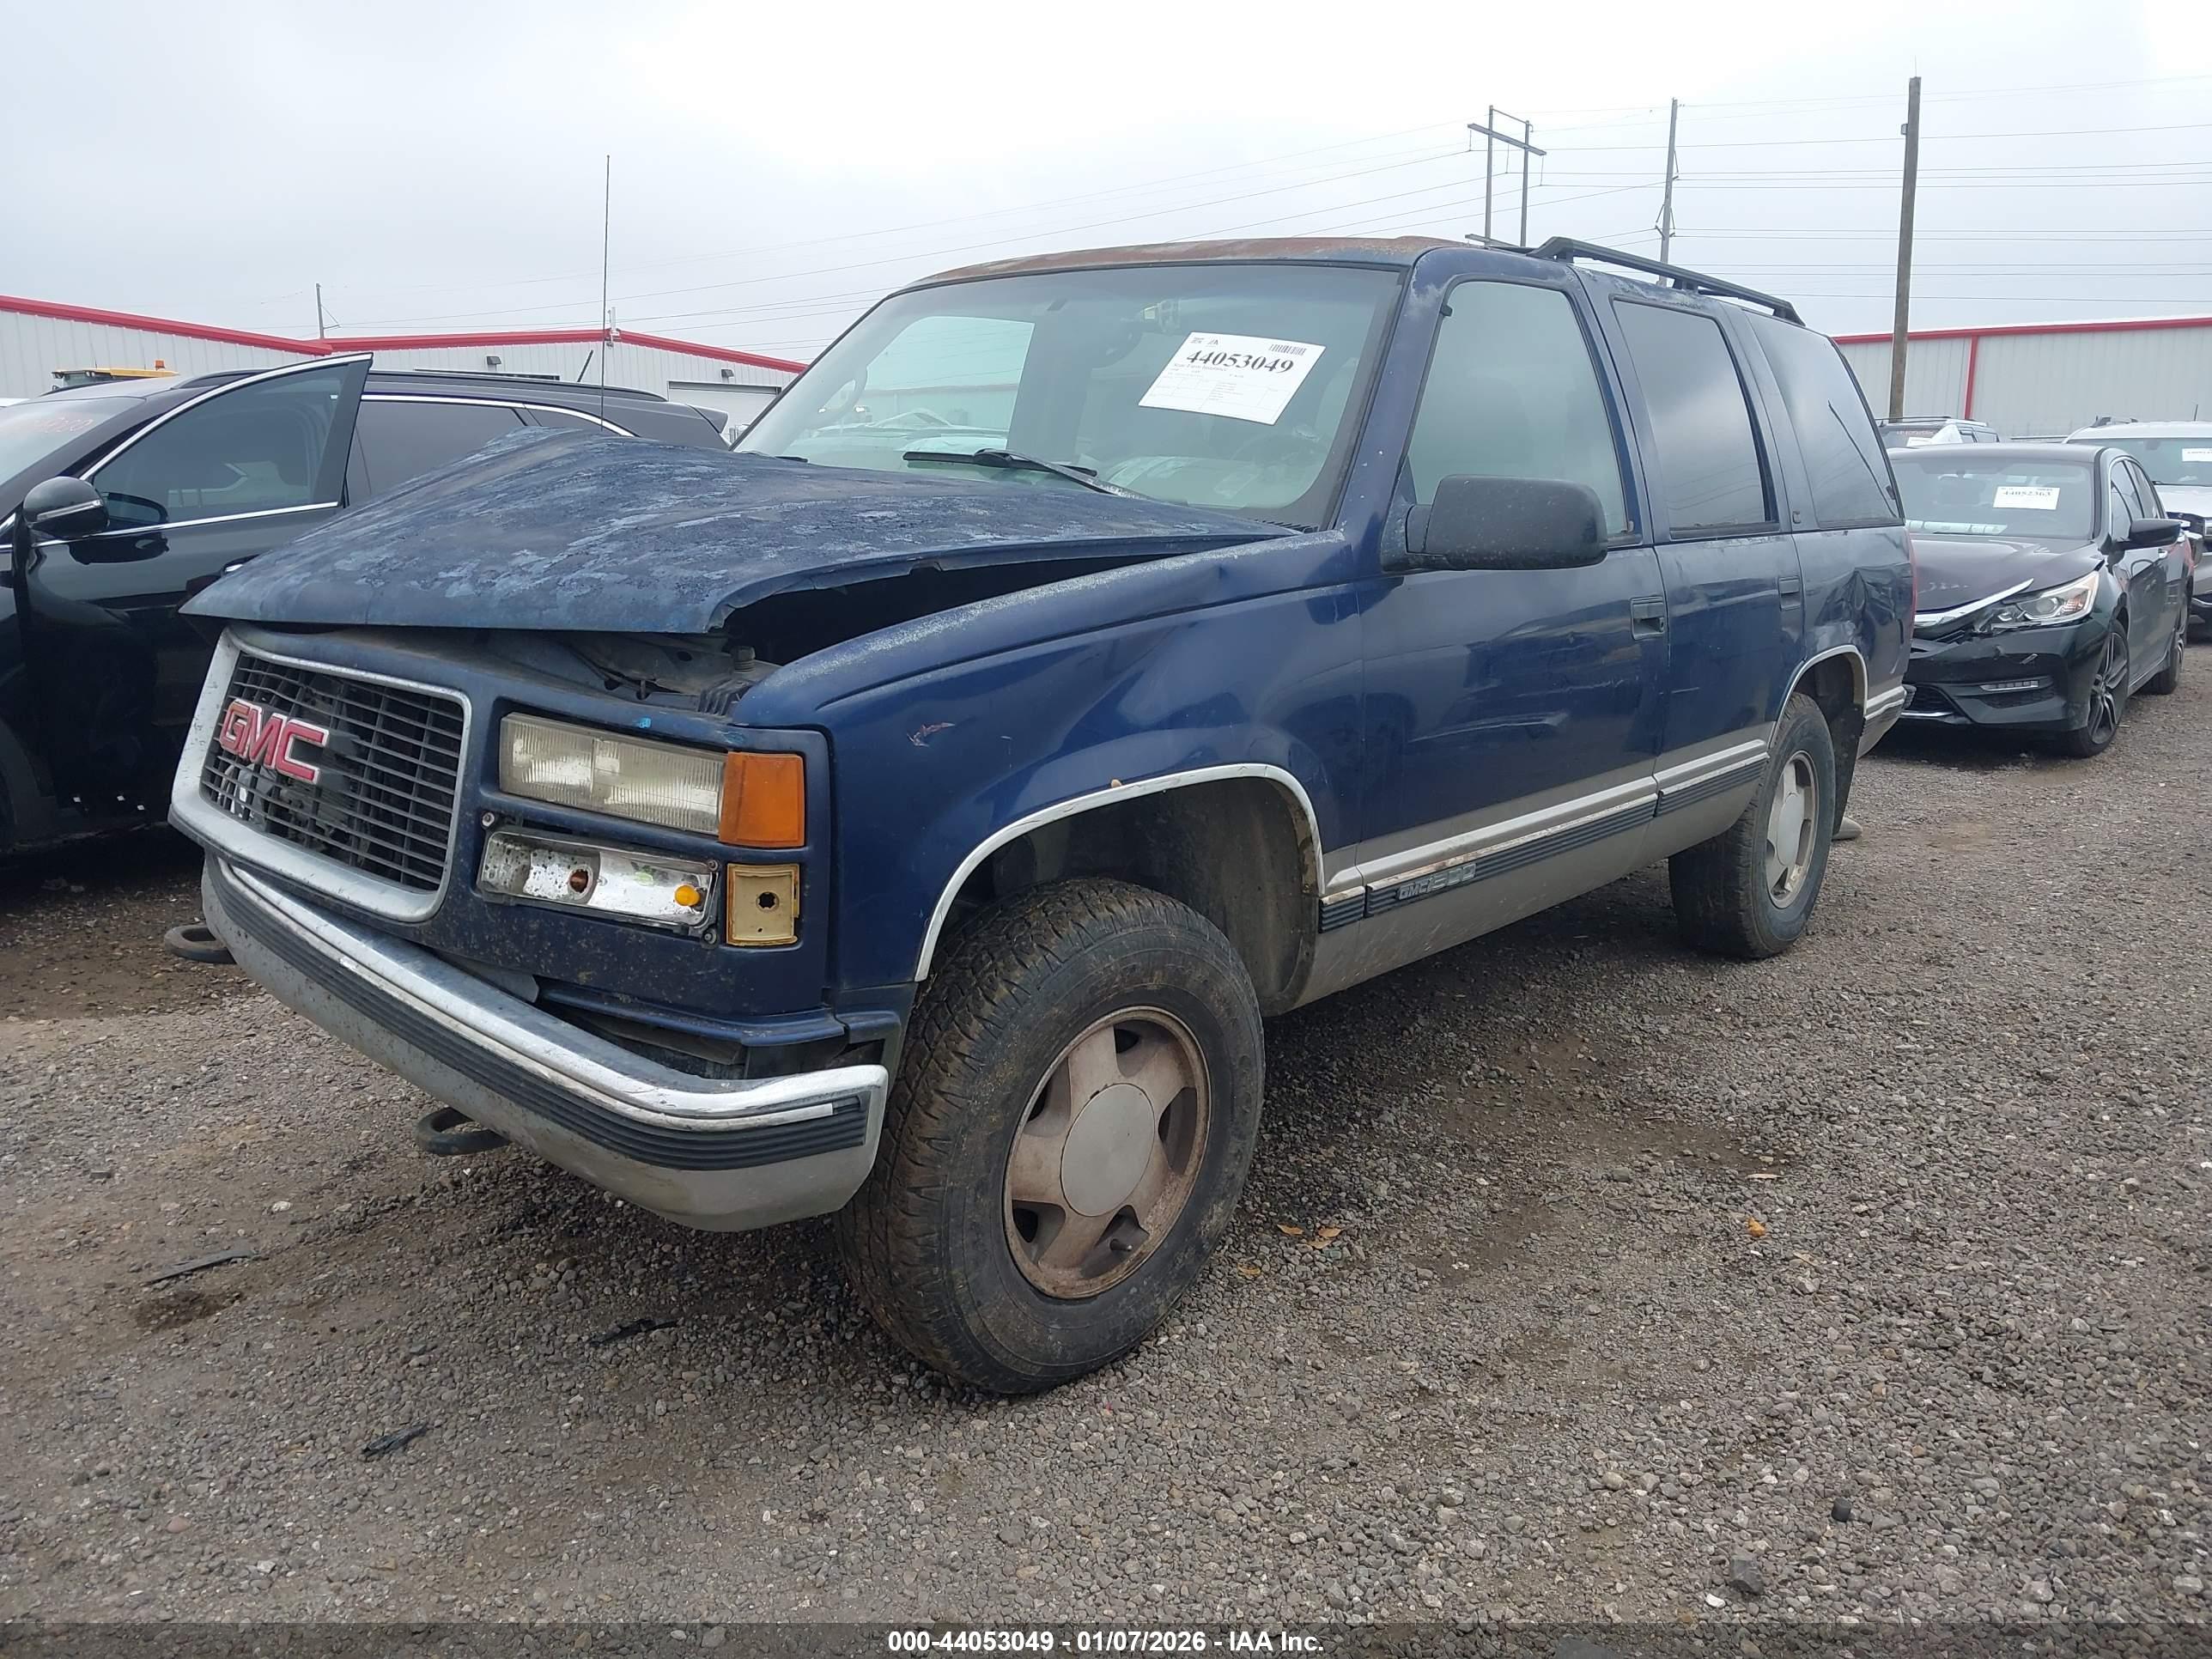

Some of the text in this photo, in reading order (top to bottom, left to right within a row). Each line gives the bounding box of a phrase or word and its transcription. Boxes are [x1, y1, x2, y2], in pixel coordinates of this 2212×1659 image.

[1187, 349, 1294, 374] 44053049
[219, 697, 329, 785] GMC
[1399, 878, 1429, 901] GMC
